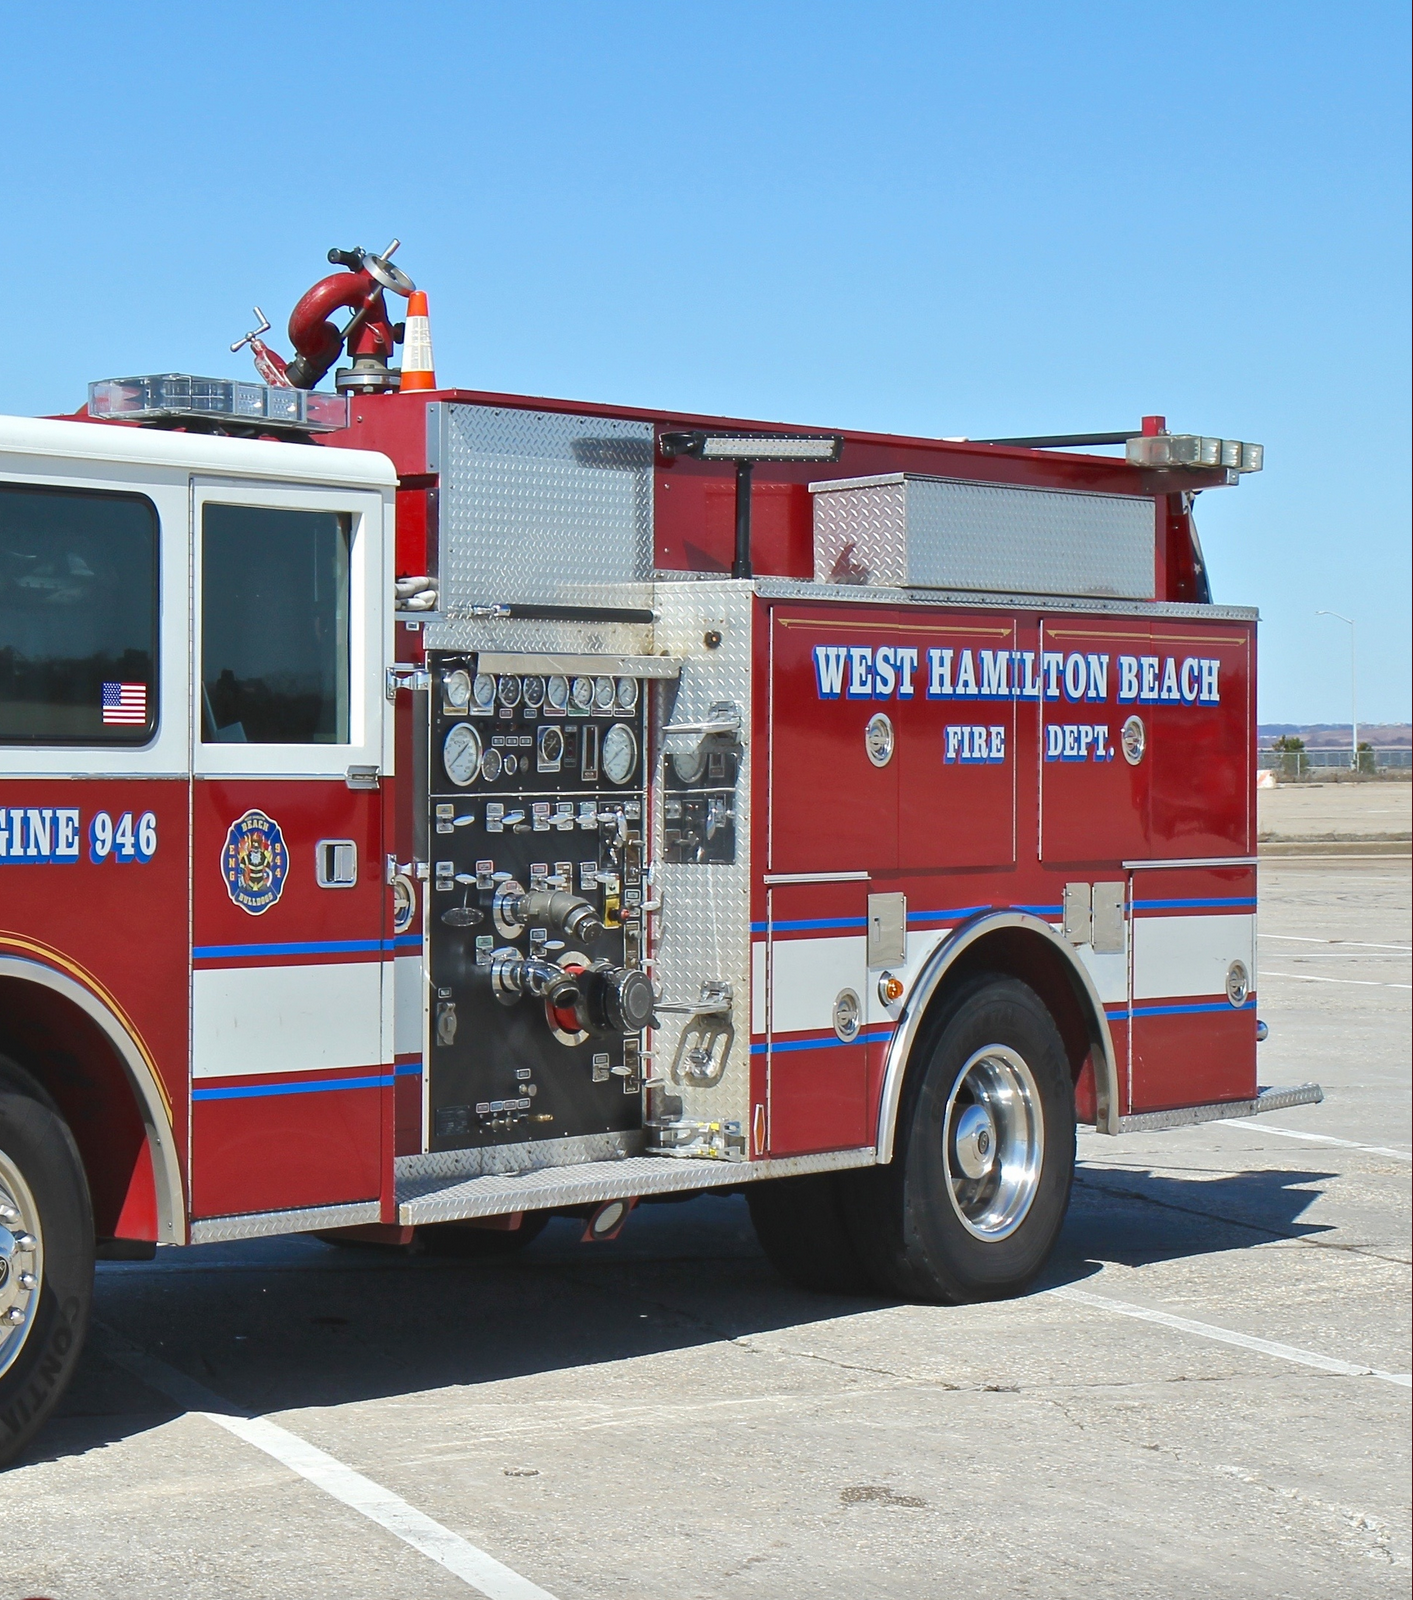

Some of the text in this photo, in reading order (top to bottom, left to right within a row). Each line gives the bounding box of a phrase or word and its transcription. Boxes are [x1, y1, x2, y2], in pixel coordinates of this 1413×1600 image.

[814, 645, 1220, 704] WEST HAMILTON BEACH
[944, 725, 1115, 762] FIRE DEPT.
[91, 811, 157, 861] 946
[241, 819, 269, 832] BEACH
